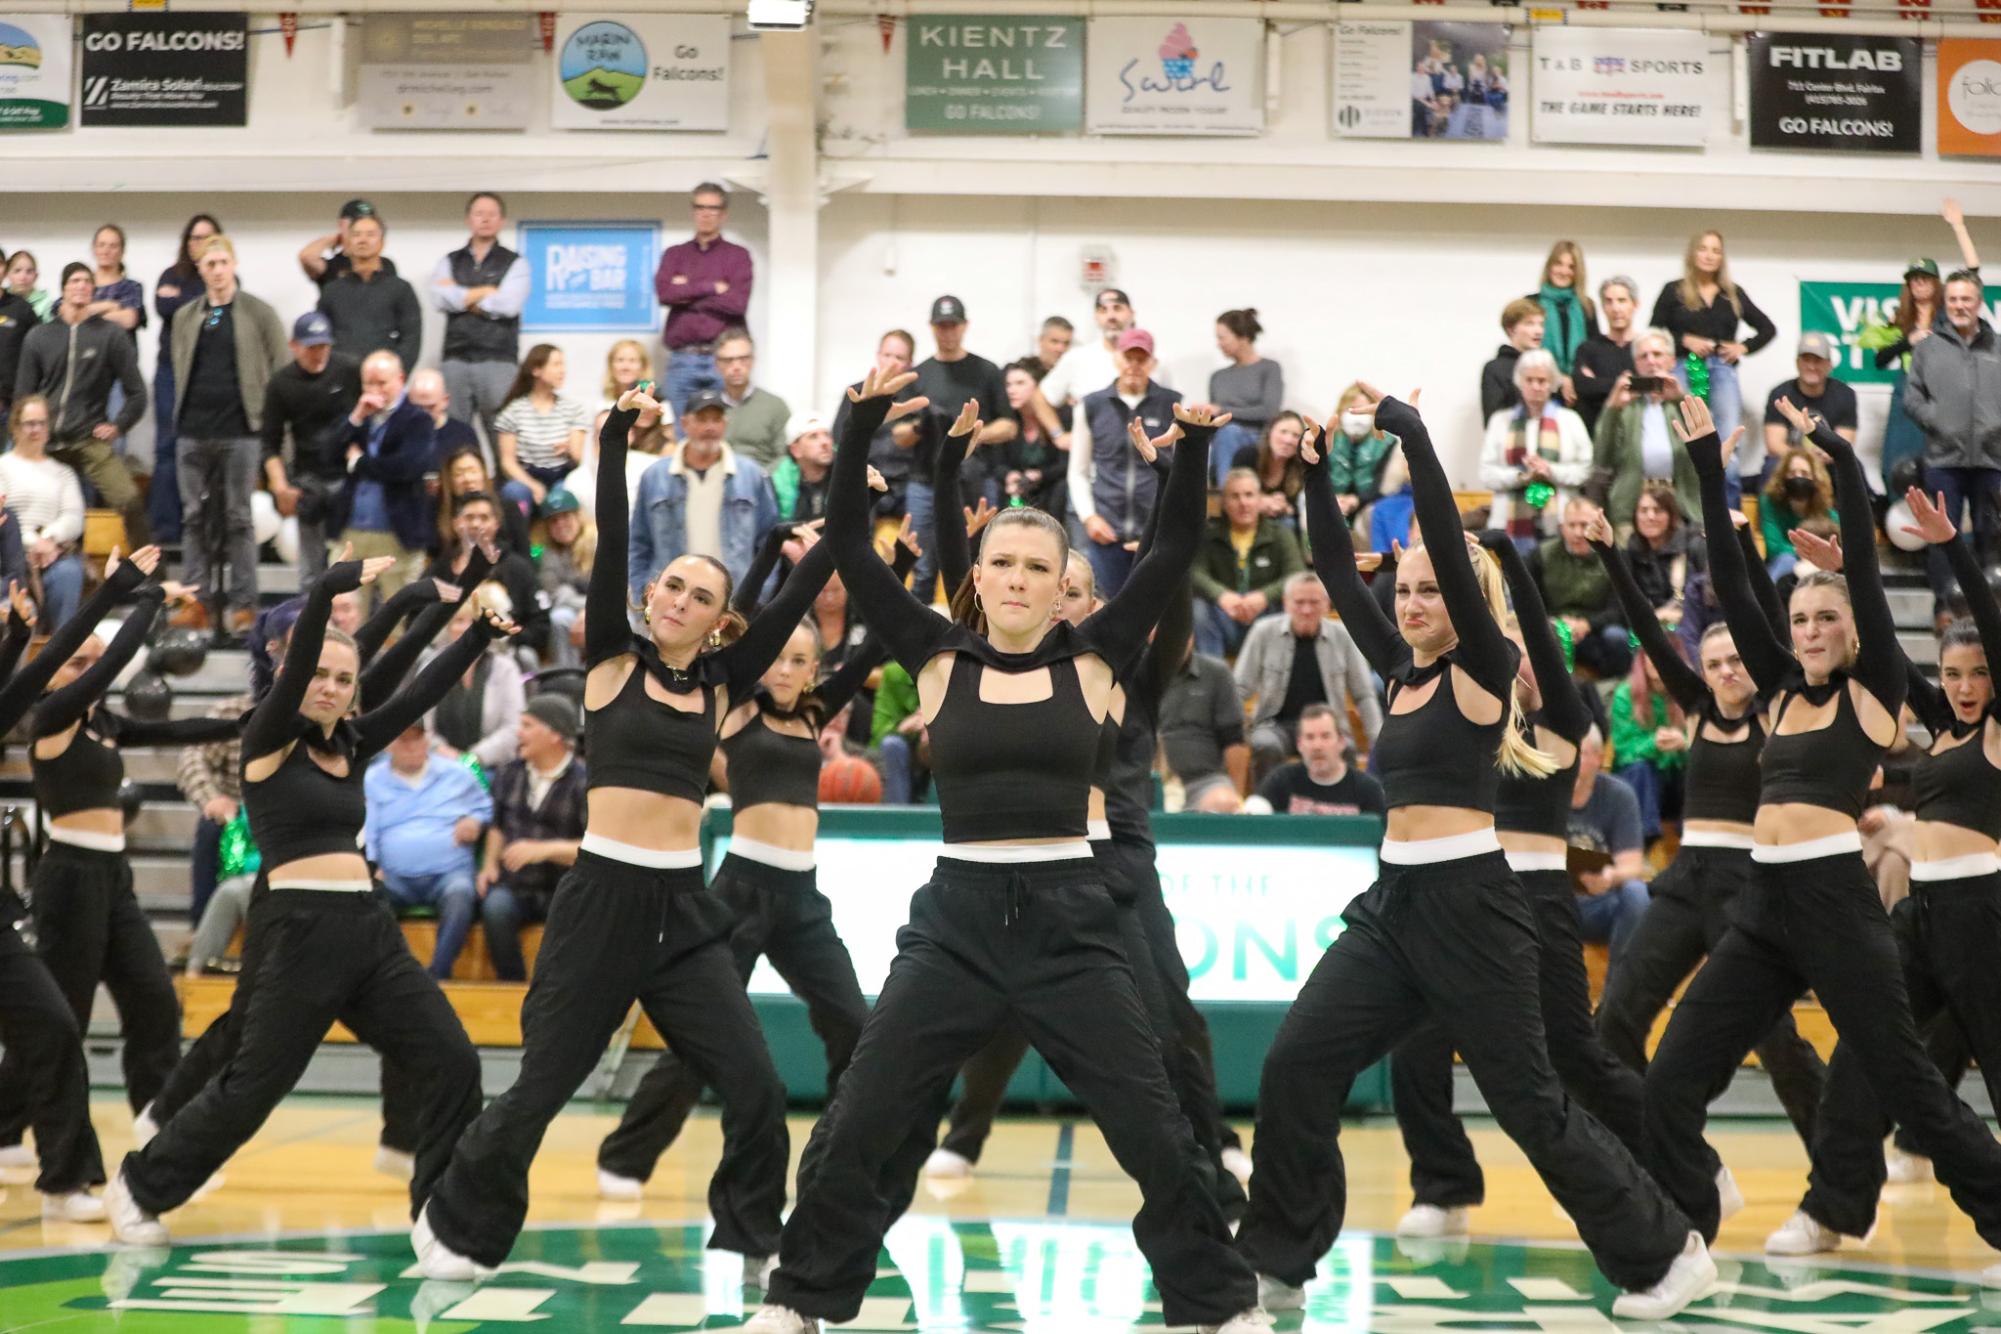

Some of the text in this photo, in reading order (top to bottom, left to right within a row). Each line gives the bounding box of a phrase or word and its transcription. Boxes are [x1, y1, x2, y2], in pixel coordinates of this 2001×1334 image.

[85, 31, 243, 51] GO FALCONS!
[576, 33, 631, 46] MARIN
[920, 26, 1067, 48] KIENTZ
[674, 44, 698, 59] Go
[1770, 46, 1902, 71] FITLAB
[653, 66, 723, 80] Falcons!
[943, 58, 1044, 80] HALL
[1540, 57, 1551, 71] T
[1570, 59, 1583, 71] B
[1631, 60, 1703, 75] SPORTS
[111, 77, 160, 91] Zamira
[1120, 57, 1230, 103] Swirl
[944, 105, 967, 119] GO
[1541, 102, 1702, 118] THE GAME STARTS HERE!
[1779, 117, 1894, 138] GO FALCONS!
[546, 244, 626, 290] RAISING
[1213, 874, 1271, 896] THE
